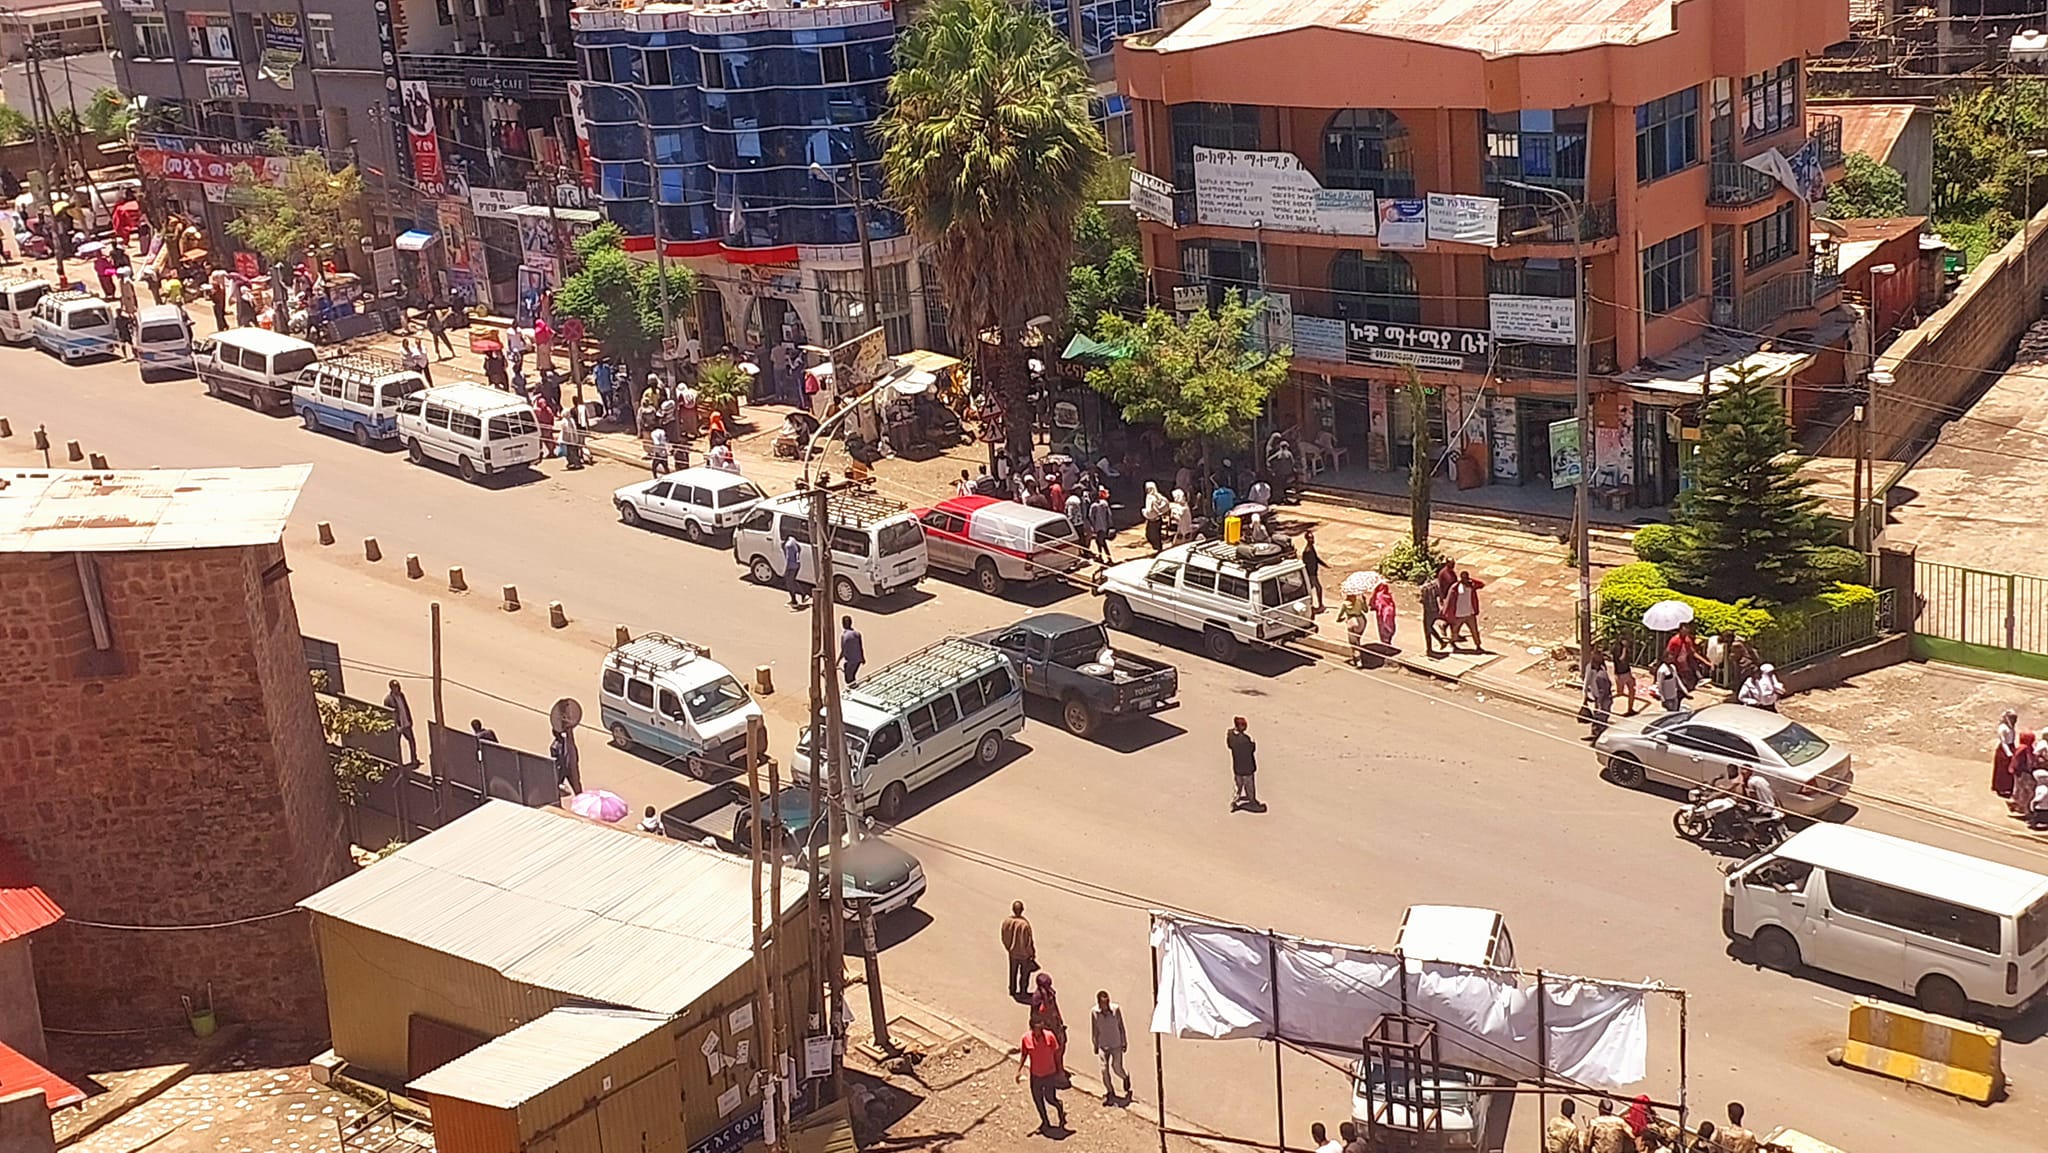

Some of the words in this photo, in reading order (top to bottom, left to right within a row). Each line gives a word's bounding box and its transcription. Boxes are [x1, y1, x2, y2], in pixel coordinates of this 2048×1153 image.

[1244, 153, 1290, 169] ማተሚያ
[1384, 326, 1452, 349] ማተሚያ
[1460, 332, 1489, 354] ቤት
[1134, 683, 1161, 696] TOYOTA
